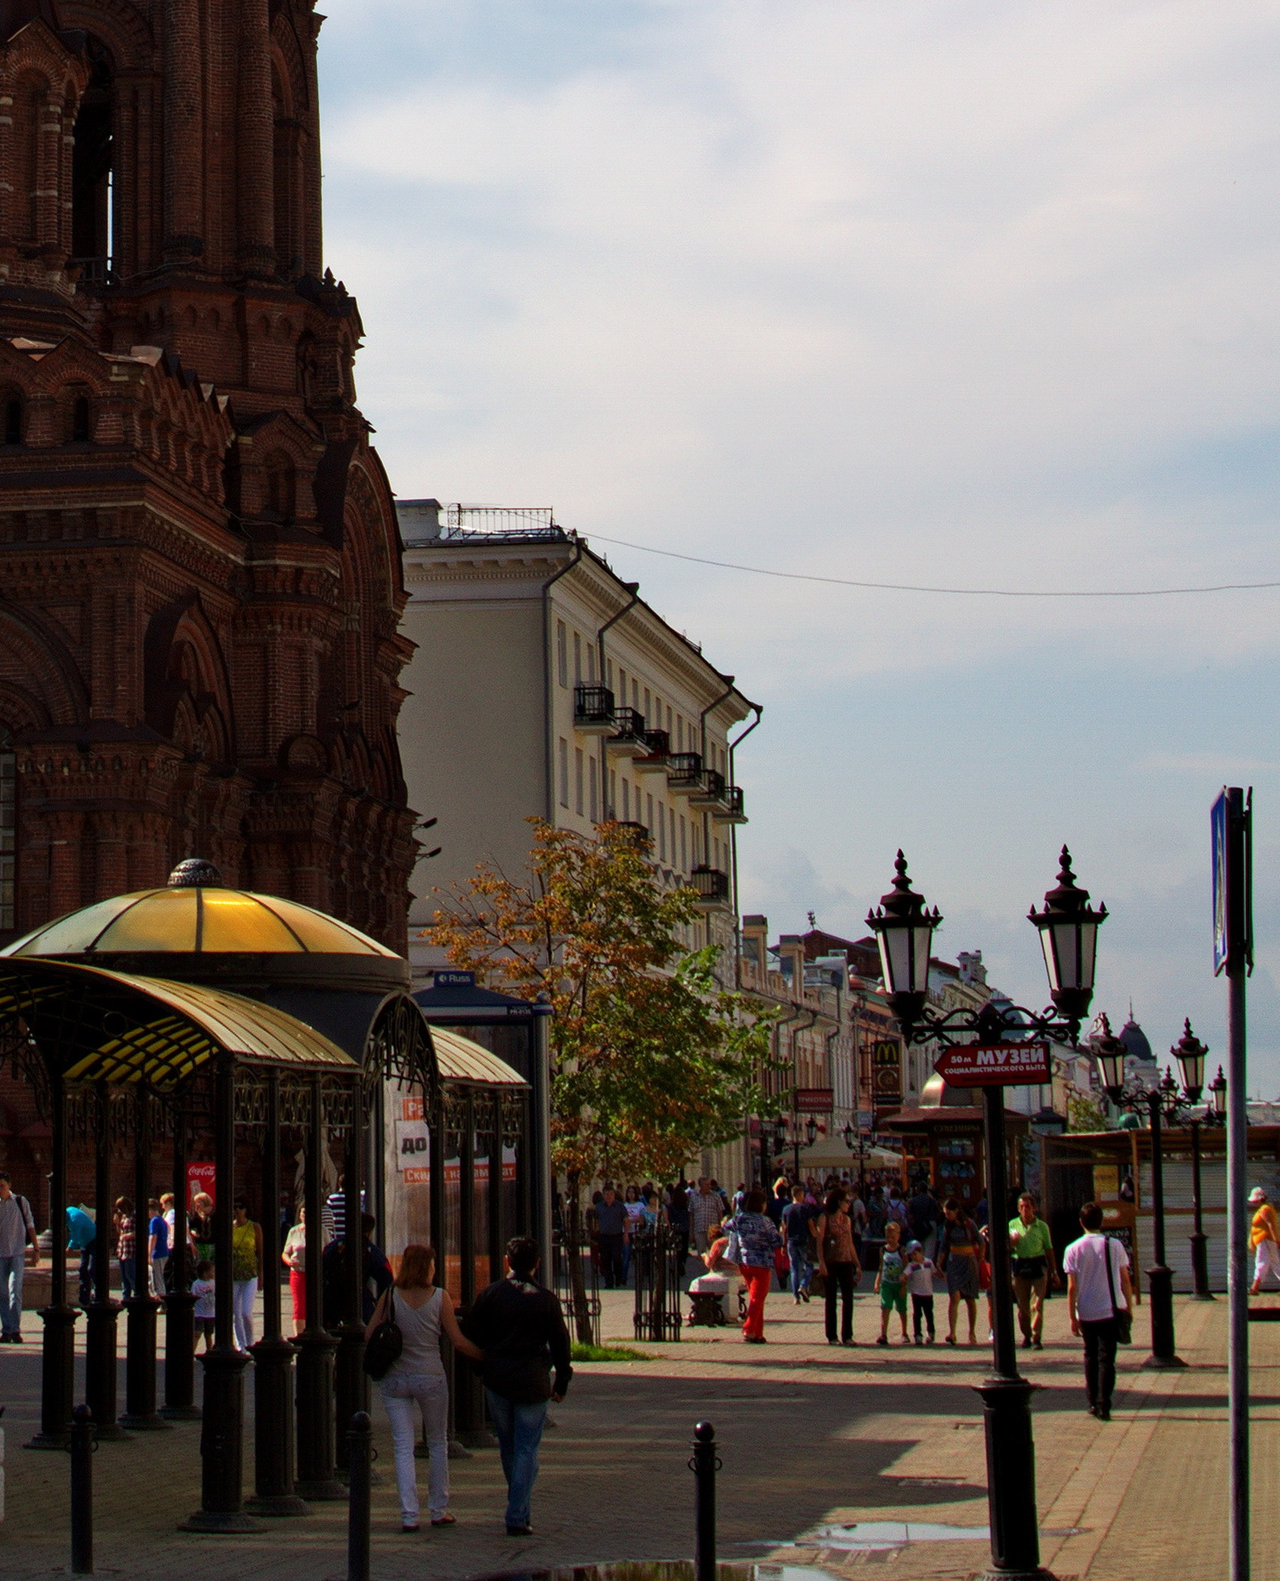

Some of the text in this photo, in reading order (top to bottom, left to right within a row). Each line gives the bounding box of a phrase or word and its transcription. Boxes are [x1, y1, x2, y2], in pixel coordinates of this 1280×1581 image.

[448, 973, 471, 983] Russ
[976, 1043, 1045, 1066] МУЗЕЙ
[944, 1063, 1047, 1075] СОЦИАЛИСТИЧЕСКОГО БЫТА
